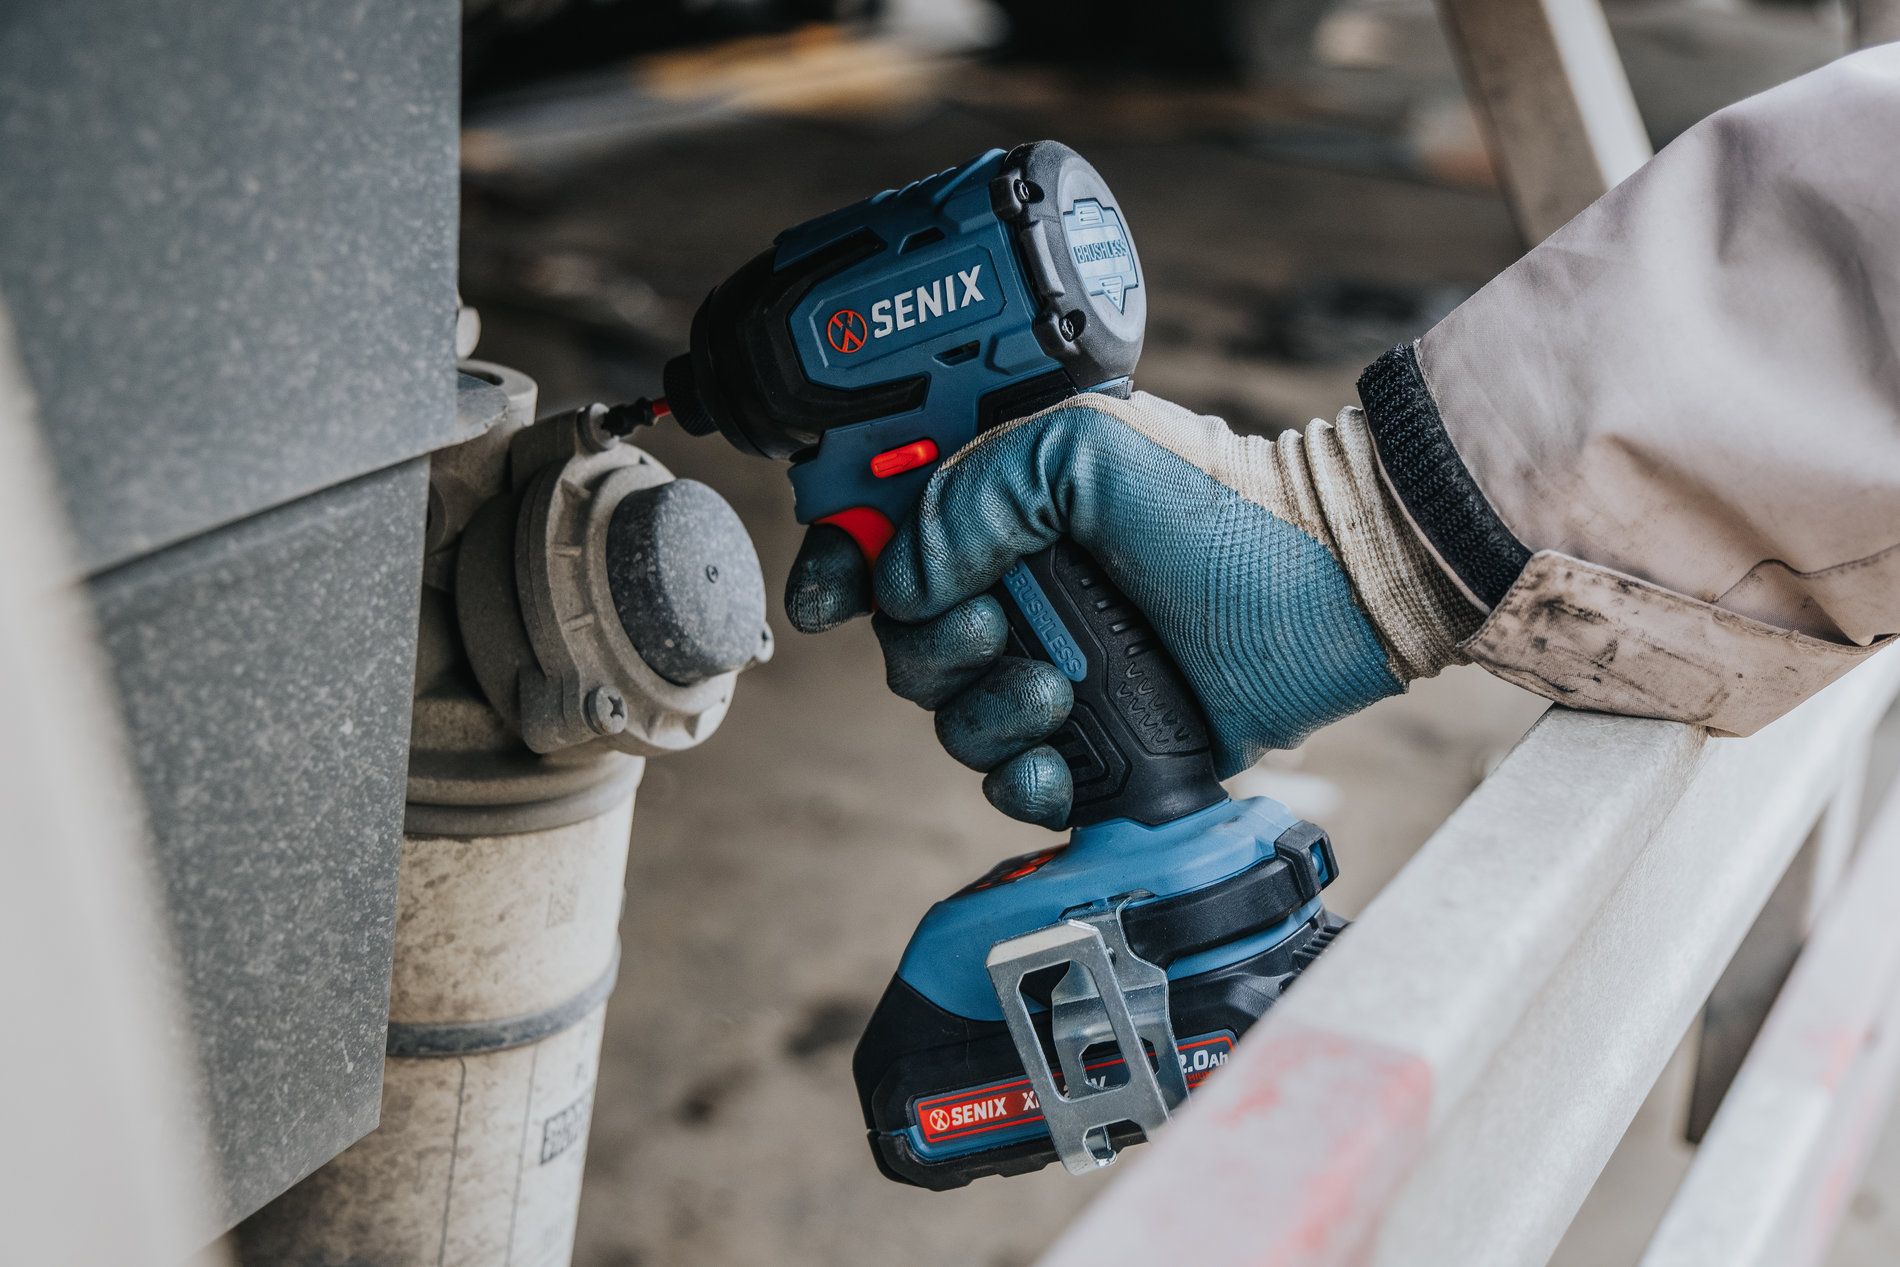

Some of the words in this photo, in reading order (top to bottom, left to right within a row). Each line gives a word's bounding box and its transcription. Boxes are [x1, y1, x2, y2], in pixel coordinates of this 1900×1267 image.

[1073, 239, 1127, 264] BRUSHLESS
[871, 264, 985, 339] SENIX
[951, 1097, 1007, 1126] SENIX
